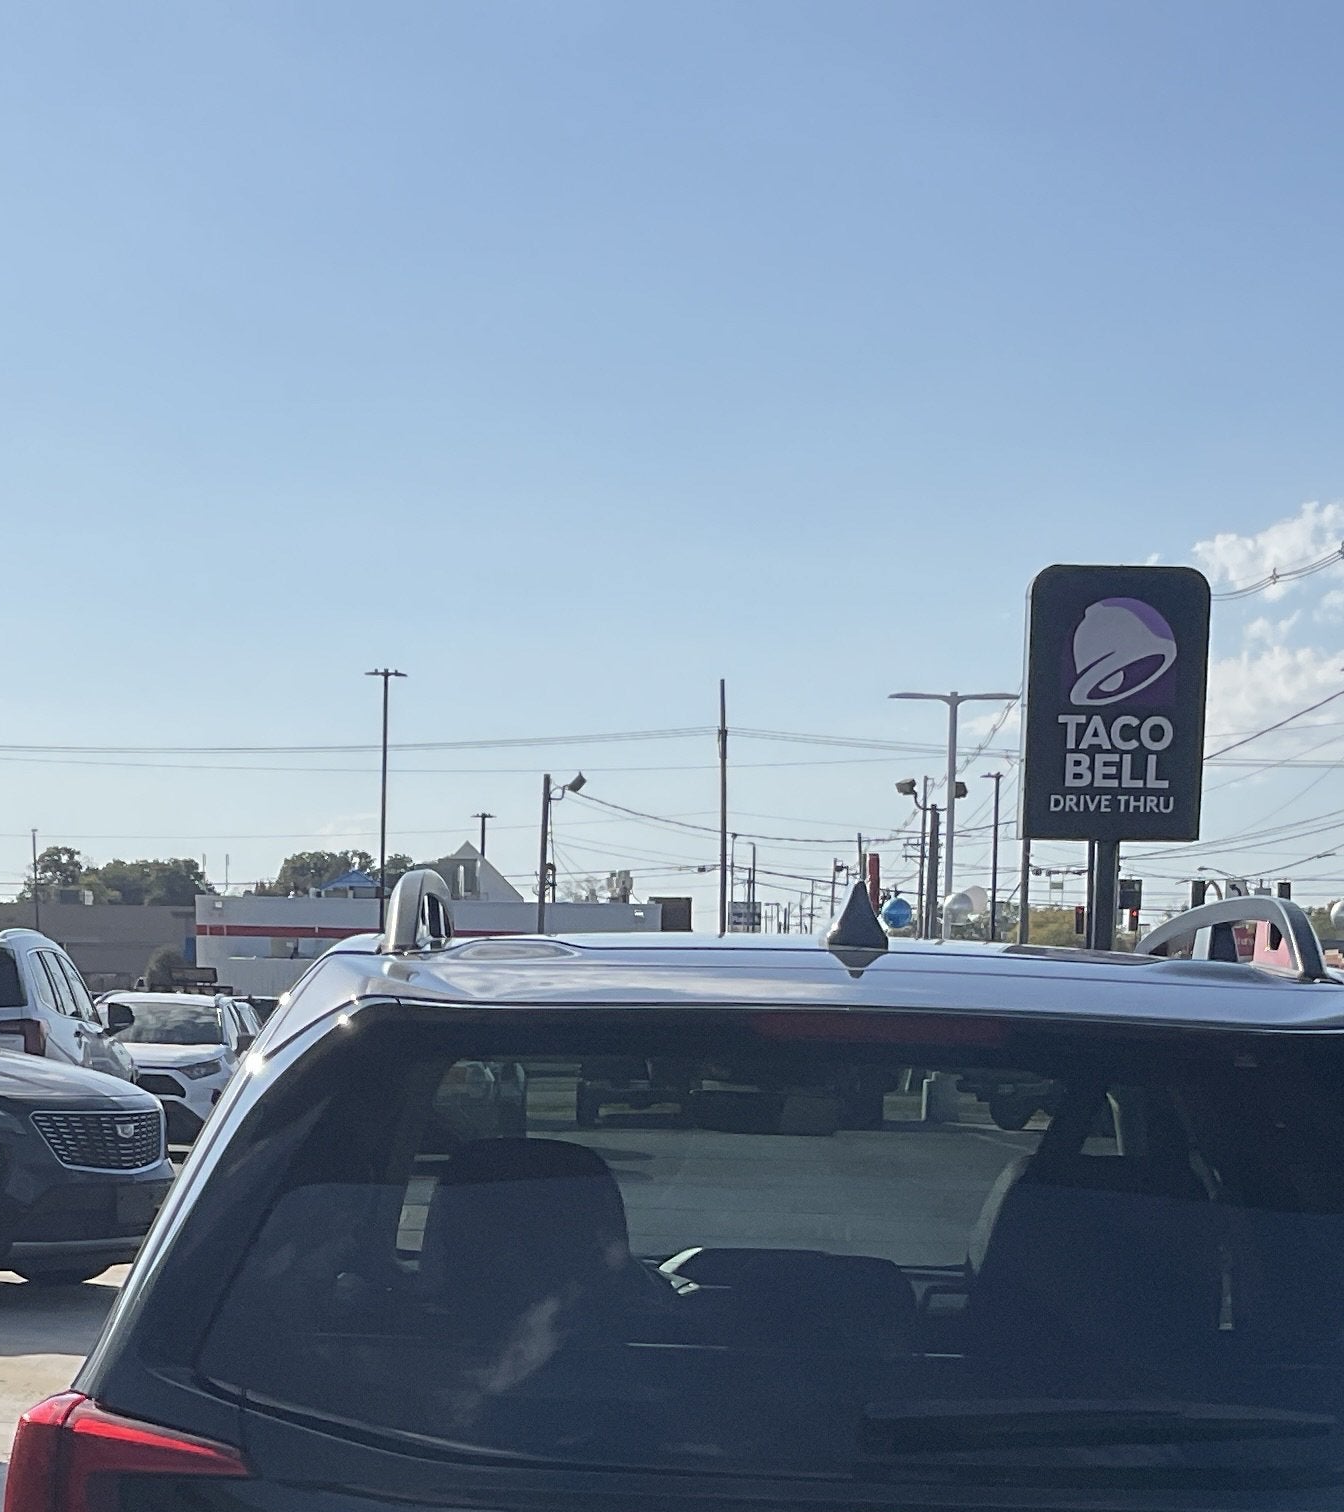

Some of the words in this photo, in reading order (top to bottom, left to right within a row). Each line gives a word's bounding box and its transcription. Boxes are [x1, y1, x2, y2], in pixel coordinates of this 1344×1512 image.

[1058, 714, 1174, 752] TACO
[1063, 753, 1170, 789] BELL
[1049, 794, 1112, 813] DRIVE
[1116, 795, 1175, 814] THRU
